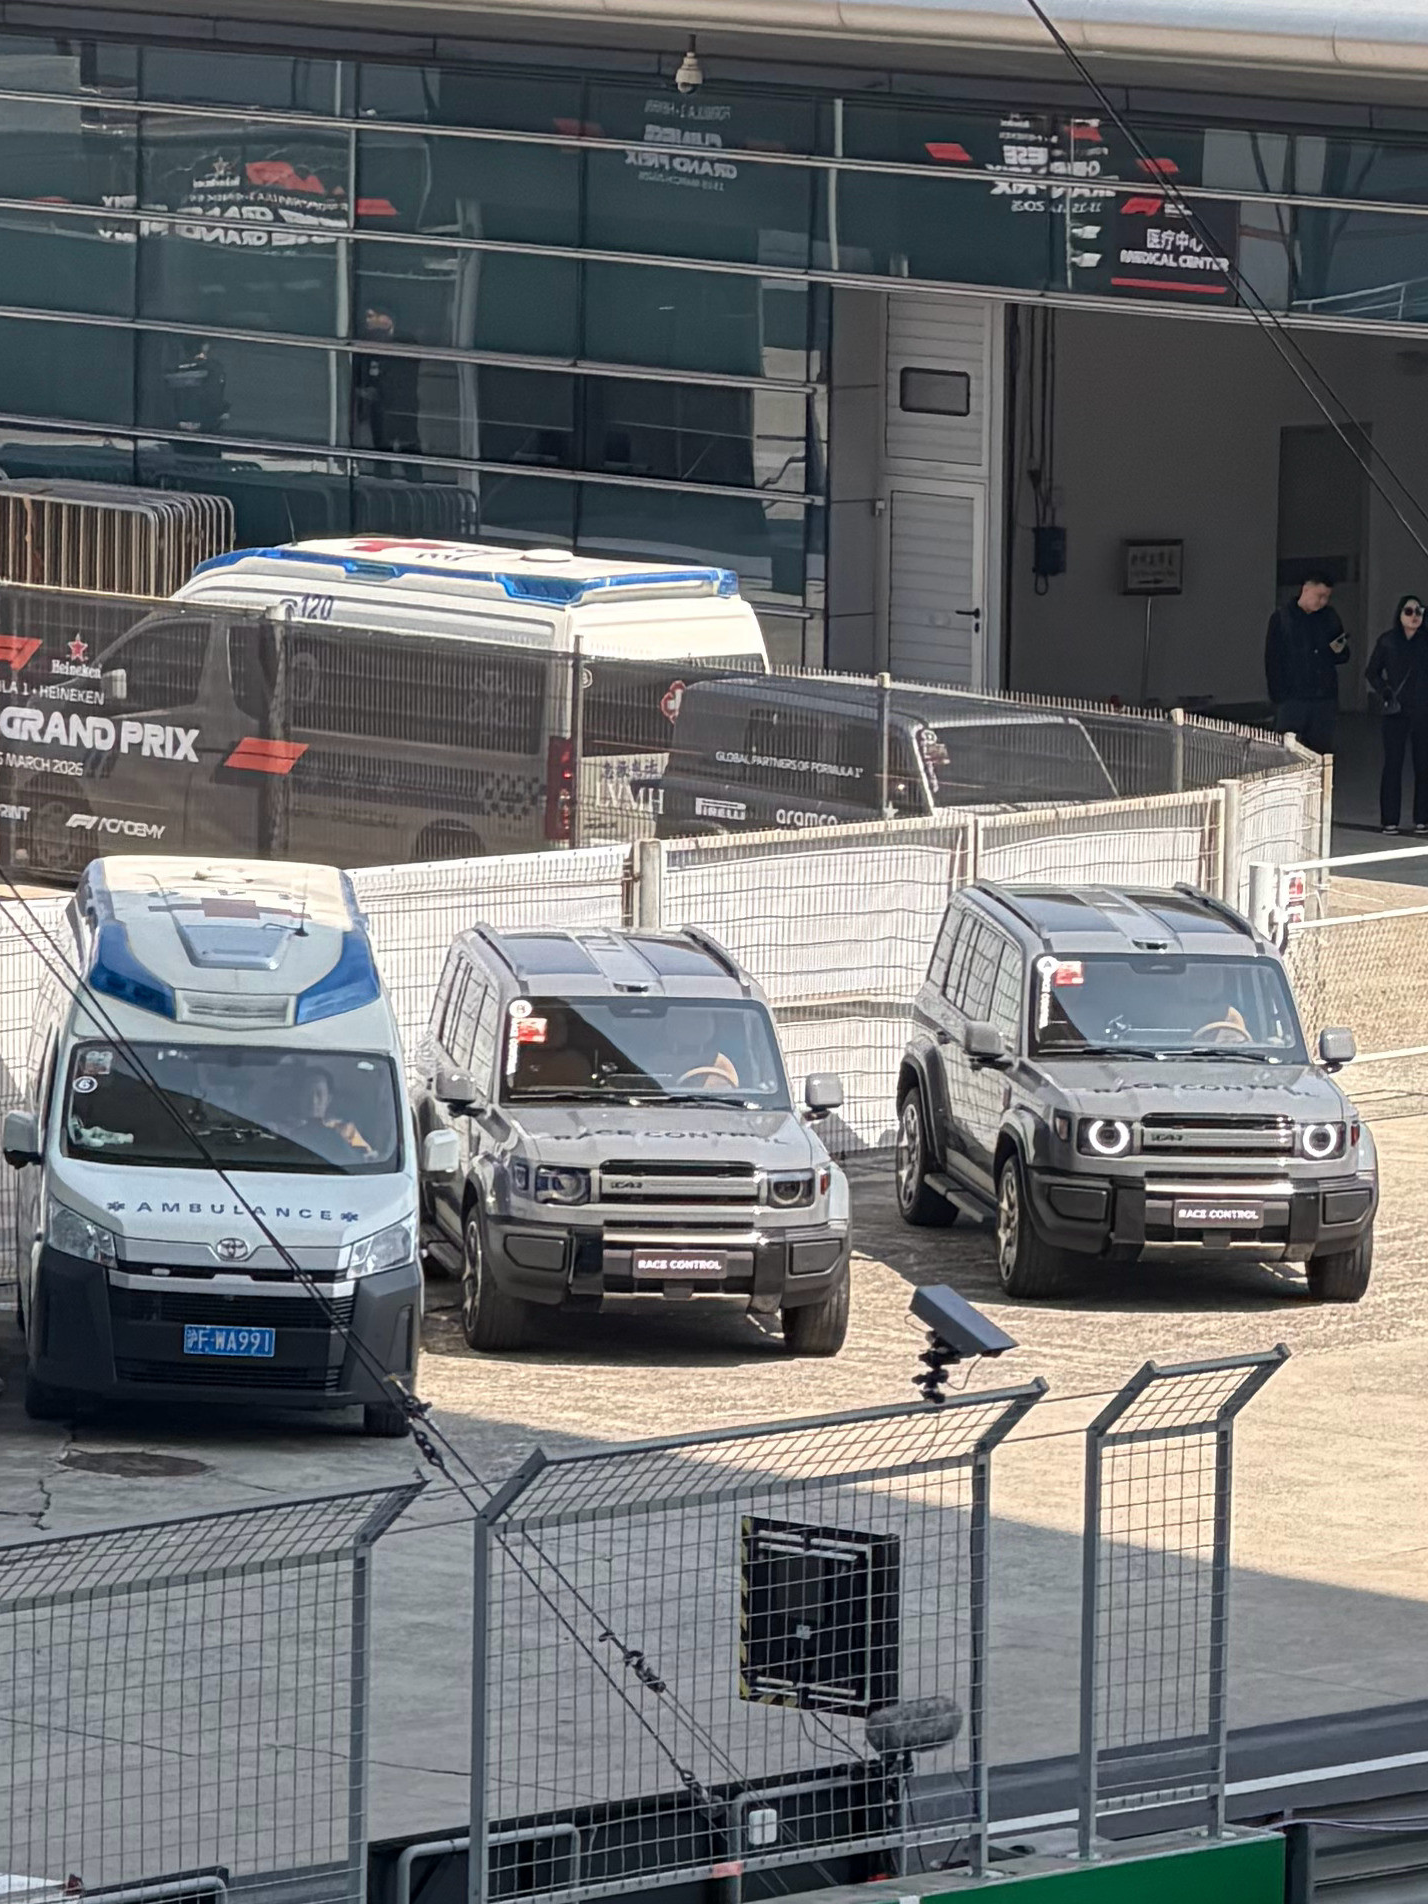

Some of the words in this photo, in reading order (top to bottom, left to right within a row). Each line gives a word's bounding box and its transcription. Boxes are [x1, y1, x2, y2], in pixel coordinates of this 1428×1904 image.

[1120, 249, 1178, 268] MEDICAL
[1178, 254, 1230, 273] CENTER
[300, 594, 335, 621] 120
[50, 659, 103, 680] Heineken
[38, 684, 105, 706] HEINEKEN
[119, 720, 201, 763] PRIX
[4, 752, 52, 774] MARCH
[52, 758, 84, 777] 2026
[715, 750, 750, 766] GLOBAL
[750, 755, 798, 772] PARTNERS
[798, 760, 811, 772] OF
[810, 760, 854, 778] FORMULA
[695, 796, 747, 821] PIRELLI
[776, 807, 839, 828] aramco
[136, 1200, 335, 1223] AMBULANCE
[1178, 1209, 1207, 1220] RACE
[1208, 1209, 1259, 1220] CONTROL
[638, 1258, 668, 1271] RACE
[668, 1258, 722, 1271] CONTROL
